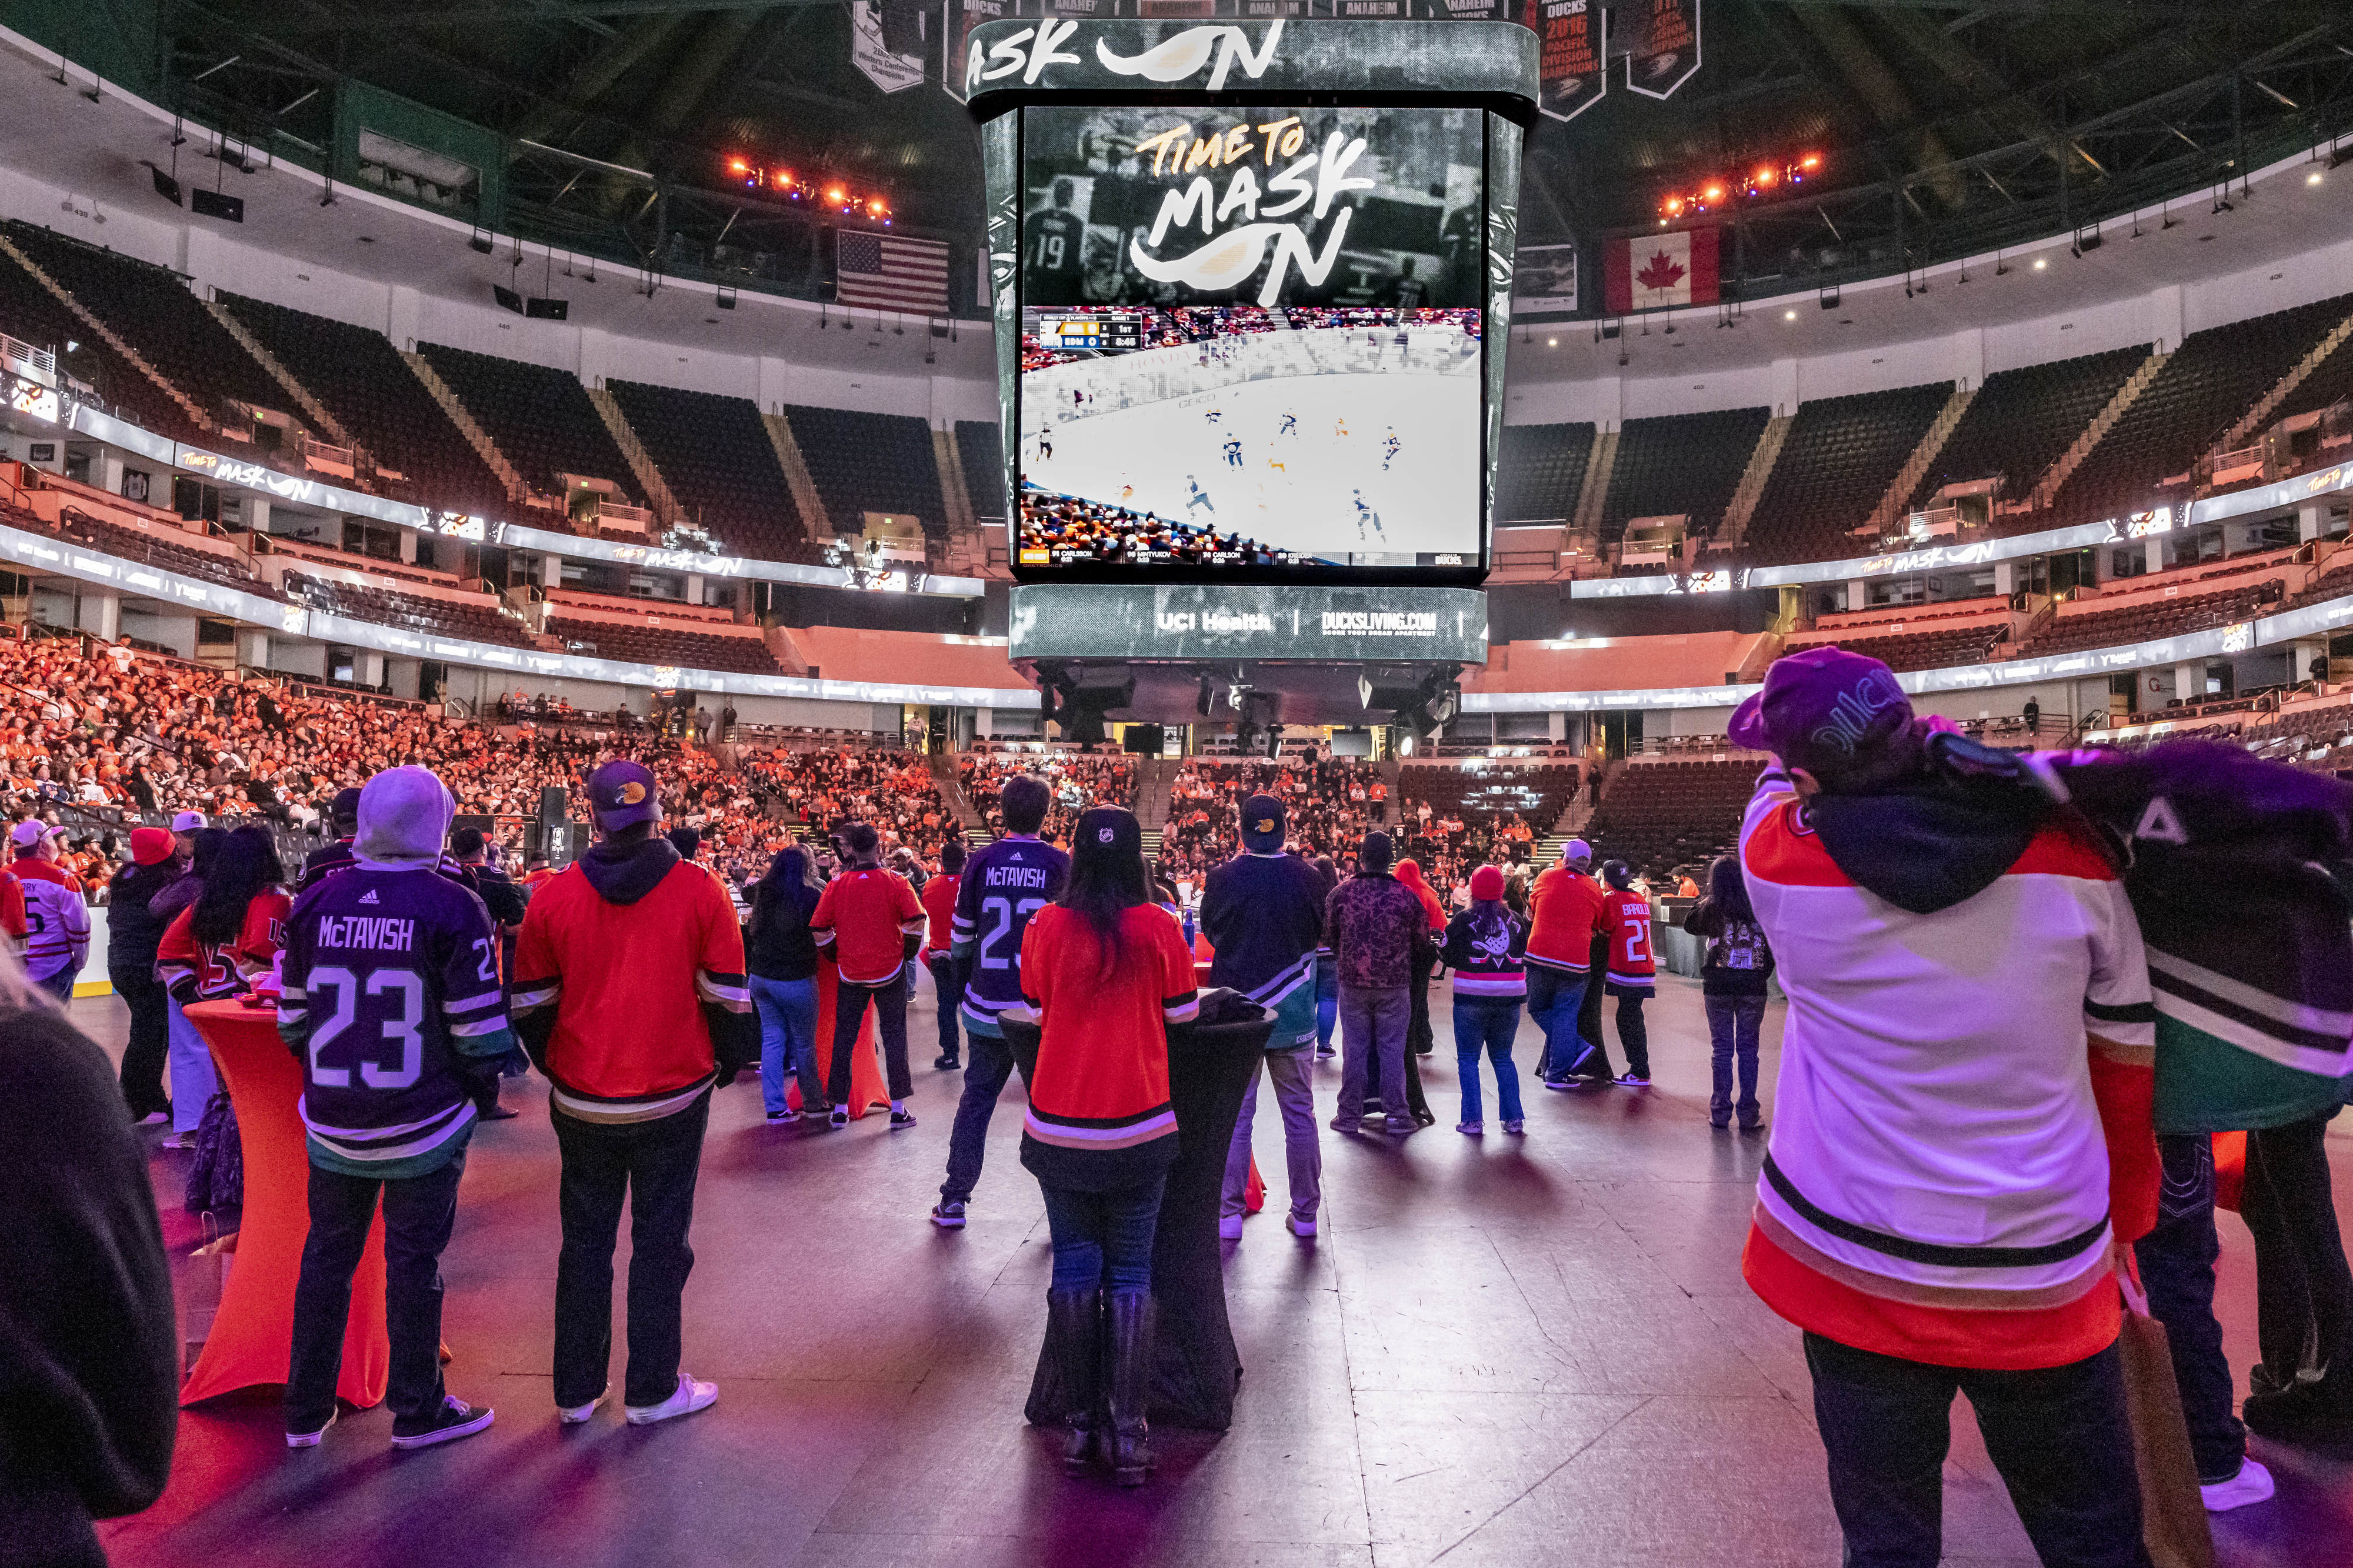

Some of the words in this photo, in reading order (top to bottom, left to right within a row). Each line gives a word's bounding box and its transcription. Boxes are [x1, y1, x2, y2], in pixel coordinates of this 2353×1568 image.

[1346, 2, 1398, 15] ANAHEIM
[1547, 0, 1587, 18] DUCKS
[1547, 35, 1587, 54] PACIFIC
[965, 18, 1081, 92] ASK
[871, 65, 905, 81] Champions
[1540, 59, 1599, 79] HAMPIONS
[1136, 123, 1255, 178] TIME
[1258, 116, 1304, 166] TO
[1148, 131, 1375, 247] MASK
[74, 209, 88, 218] 438
[1036, 235, 1066, 269] 19
[1129, 206, 1352, 308] ON
[296, 273, 310, 282] 439
[1064, 337, 1084, 346] EDM
[1088, 336, 1097, 346] 0
[1178, 393, 1215, 409] GEICO
[214, 463, 265, 487] MASK
[644, 552, 694, 570] MASK
[1860, 561, 1883, 573] TIME
[1892, 548, 1944, 573] MASK
[1158, 612, 1195, 630] UCI
[1202, 612, 1271, 630] Health
[1322, 612, 1437, 630] DUCKSLIVING.COM
[1397, 828, 1404, 837] 8
[985, 866, 1046, 889] McTAVISH
[268, 916, 288, 949] 15
[318, 916, 414, 952] McTAVISH
[306, 965, 424, 1089] 23
